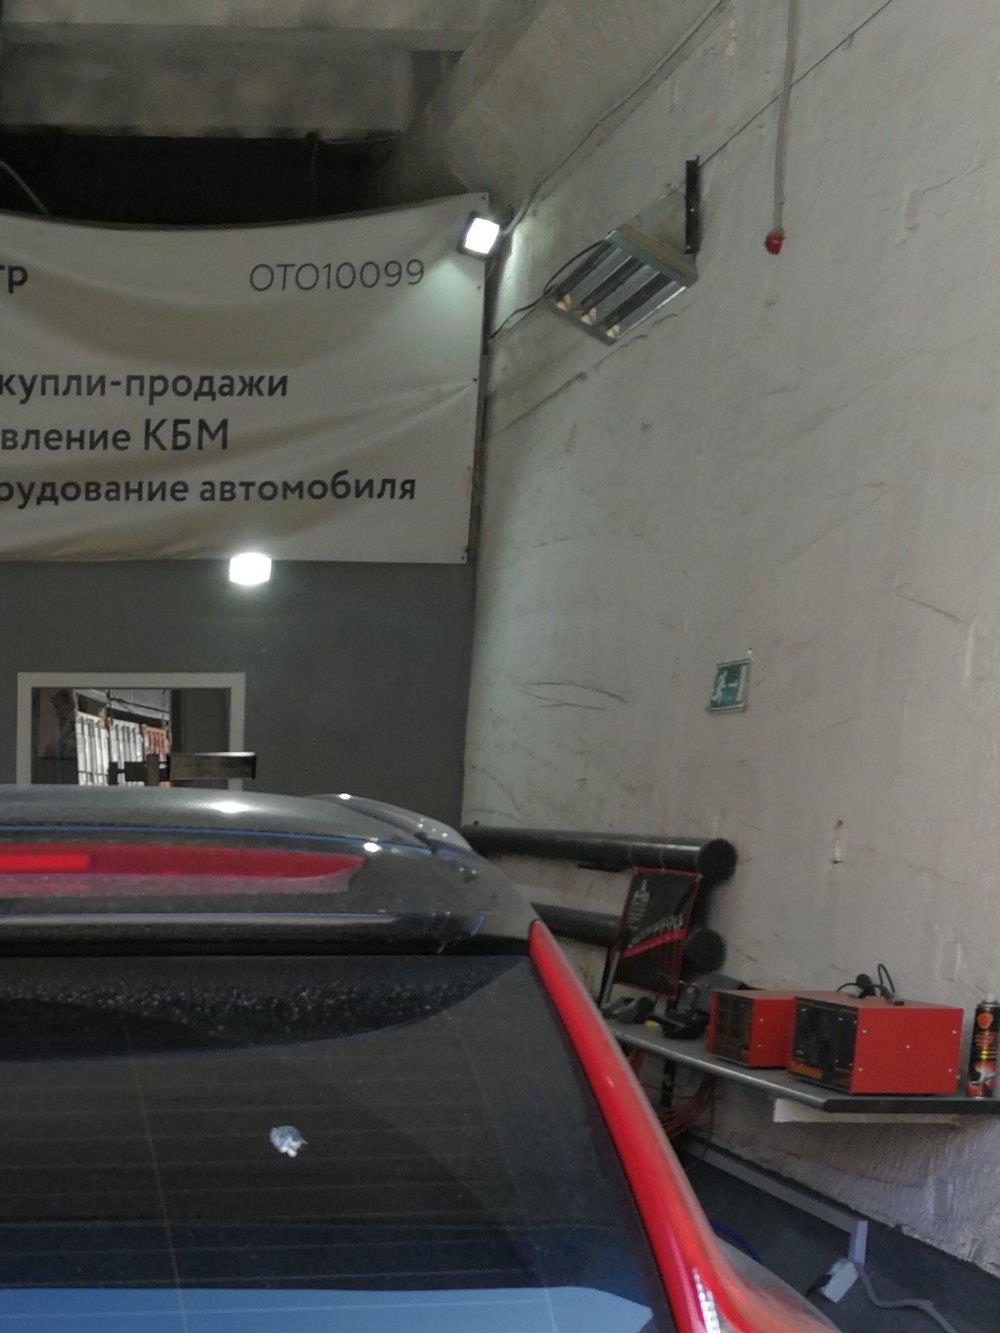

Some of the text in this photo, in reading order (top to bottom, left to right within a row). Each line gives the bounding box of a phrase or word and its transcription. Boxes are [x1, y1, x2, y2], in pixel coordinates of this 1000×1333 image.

[248, 258, 425, 292] ОТО10099
[143, 418, 229, 452] КБМ
[199, 470, 416, 502] автомобиля
